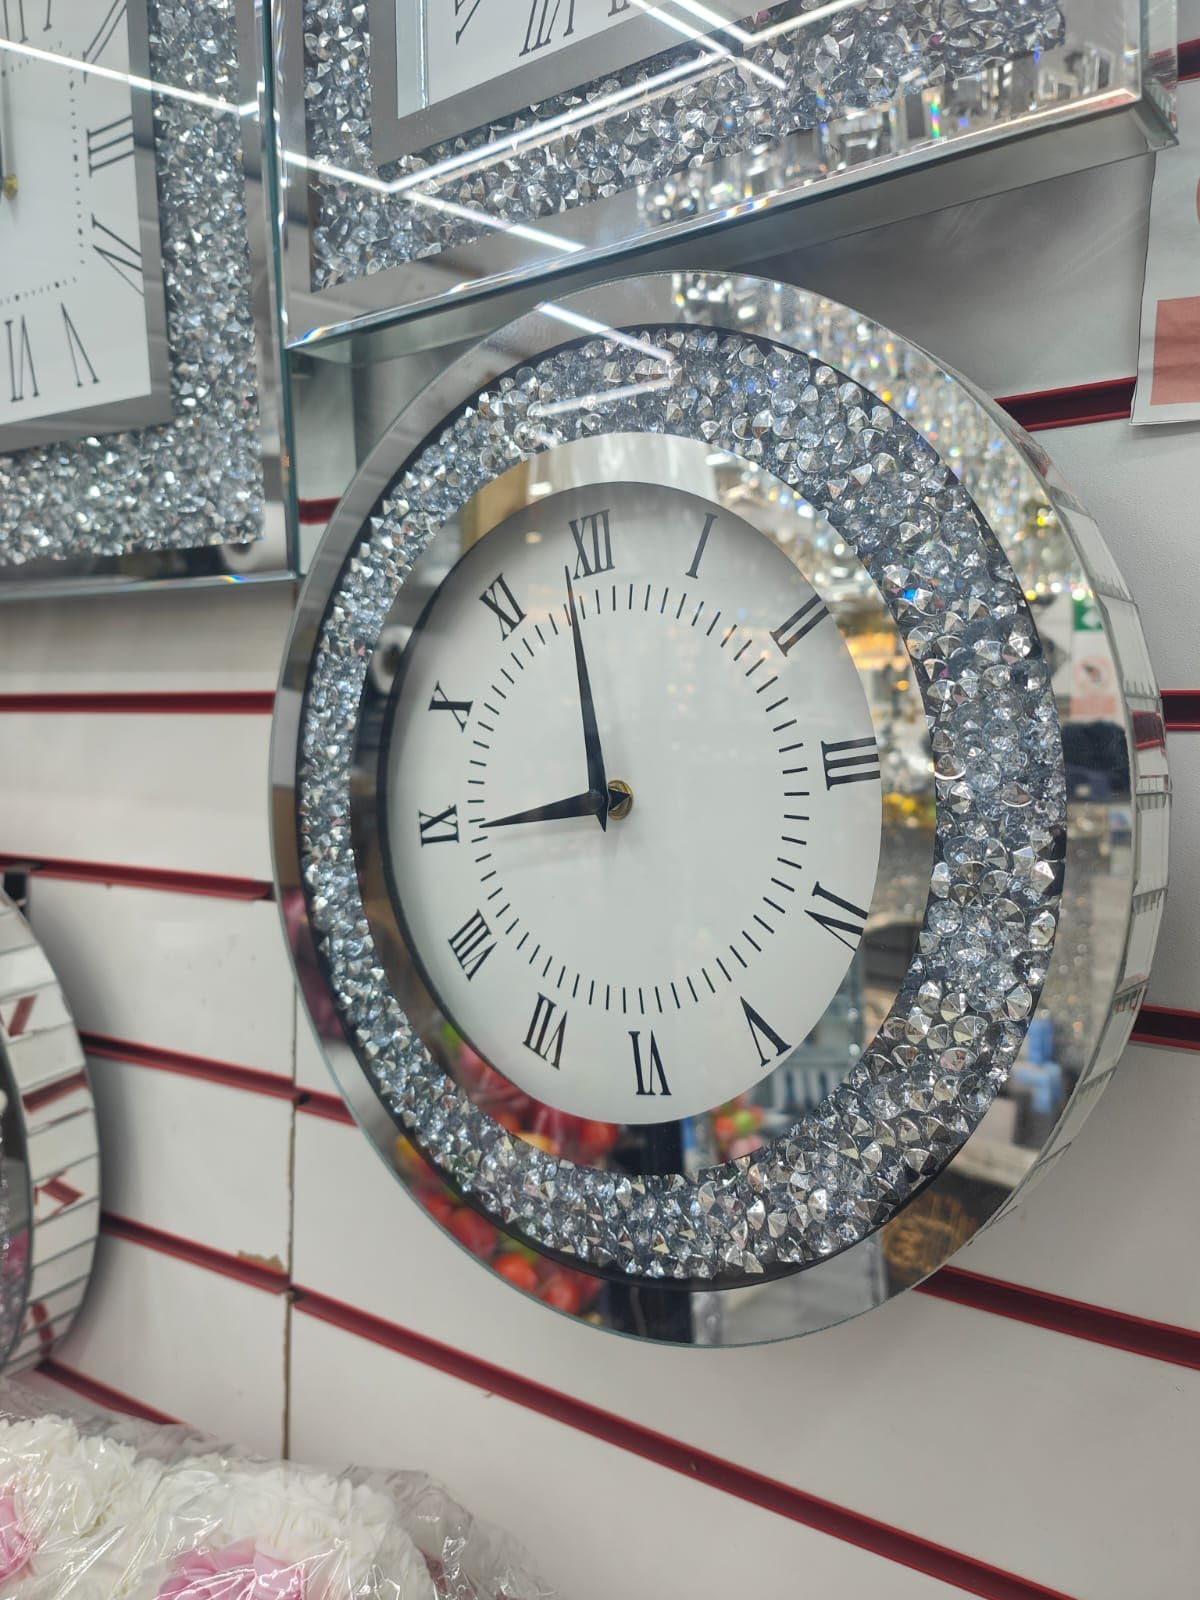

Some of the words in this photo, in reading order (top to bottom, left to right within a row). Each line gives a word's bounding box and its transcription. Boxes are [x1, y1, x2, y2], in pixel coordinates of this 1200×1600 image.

[86, 114, 135, 178] III
[91, 213, 145, 297] IV
[4, 314, 40, 403] VI
[60, 302, 101, 388] V
[569, 509, 615, 580] XII
[685, 511, 718, 579] I
[479, 573, 527, 641] XI
[769, 593, 830, 657] II
[428, 680, 473, 732] X
[821, 736, 881, 790] III
[418, 804, 460, 848] IX
[448, 908, 498, 982] VIII
[804, 881, 869, 952] IV
[522, 992, 568, 1070] VII
[628, 1029, 672, 1096] VI
[740, 996, 792, 1067] V
